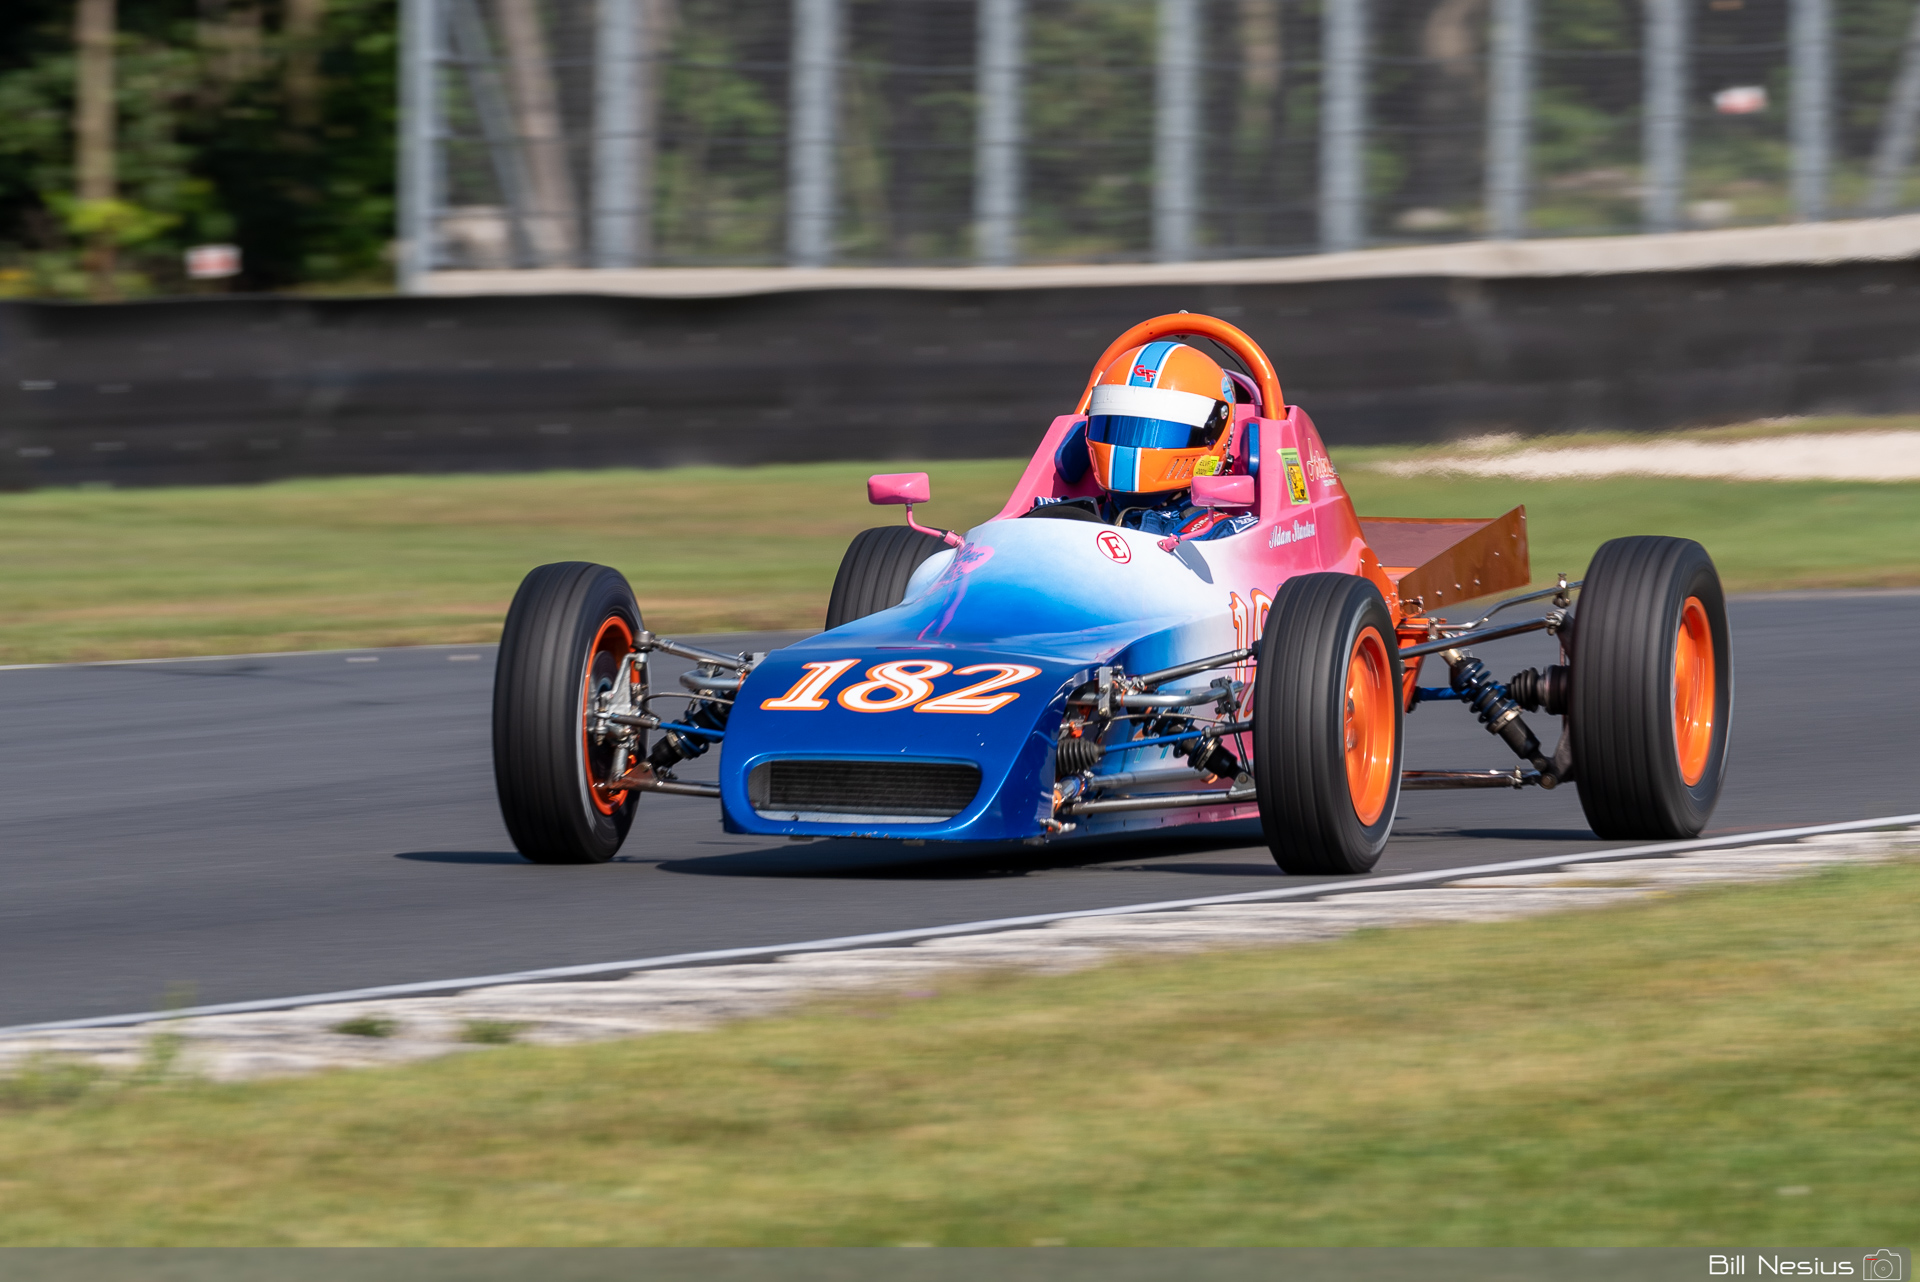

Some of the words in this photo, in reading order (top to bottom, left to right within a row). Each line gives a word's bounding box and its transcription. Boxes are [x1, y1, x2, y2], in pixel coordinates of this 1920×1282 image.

[1101, 535, 1128, 559] E
[1268, 525, 1292, 549] Adam
[760, 658, 1043, 714] 182
